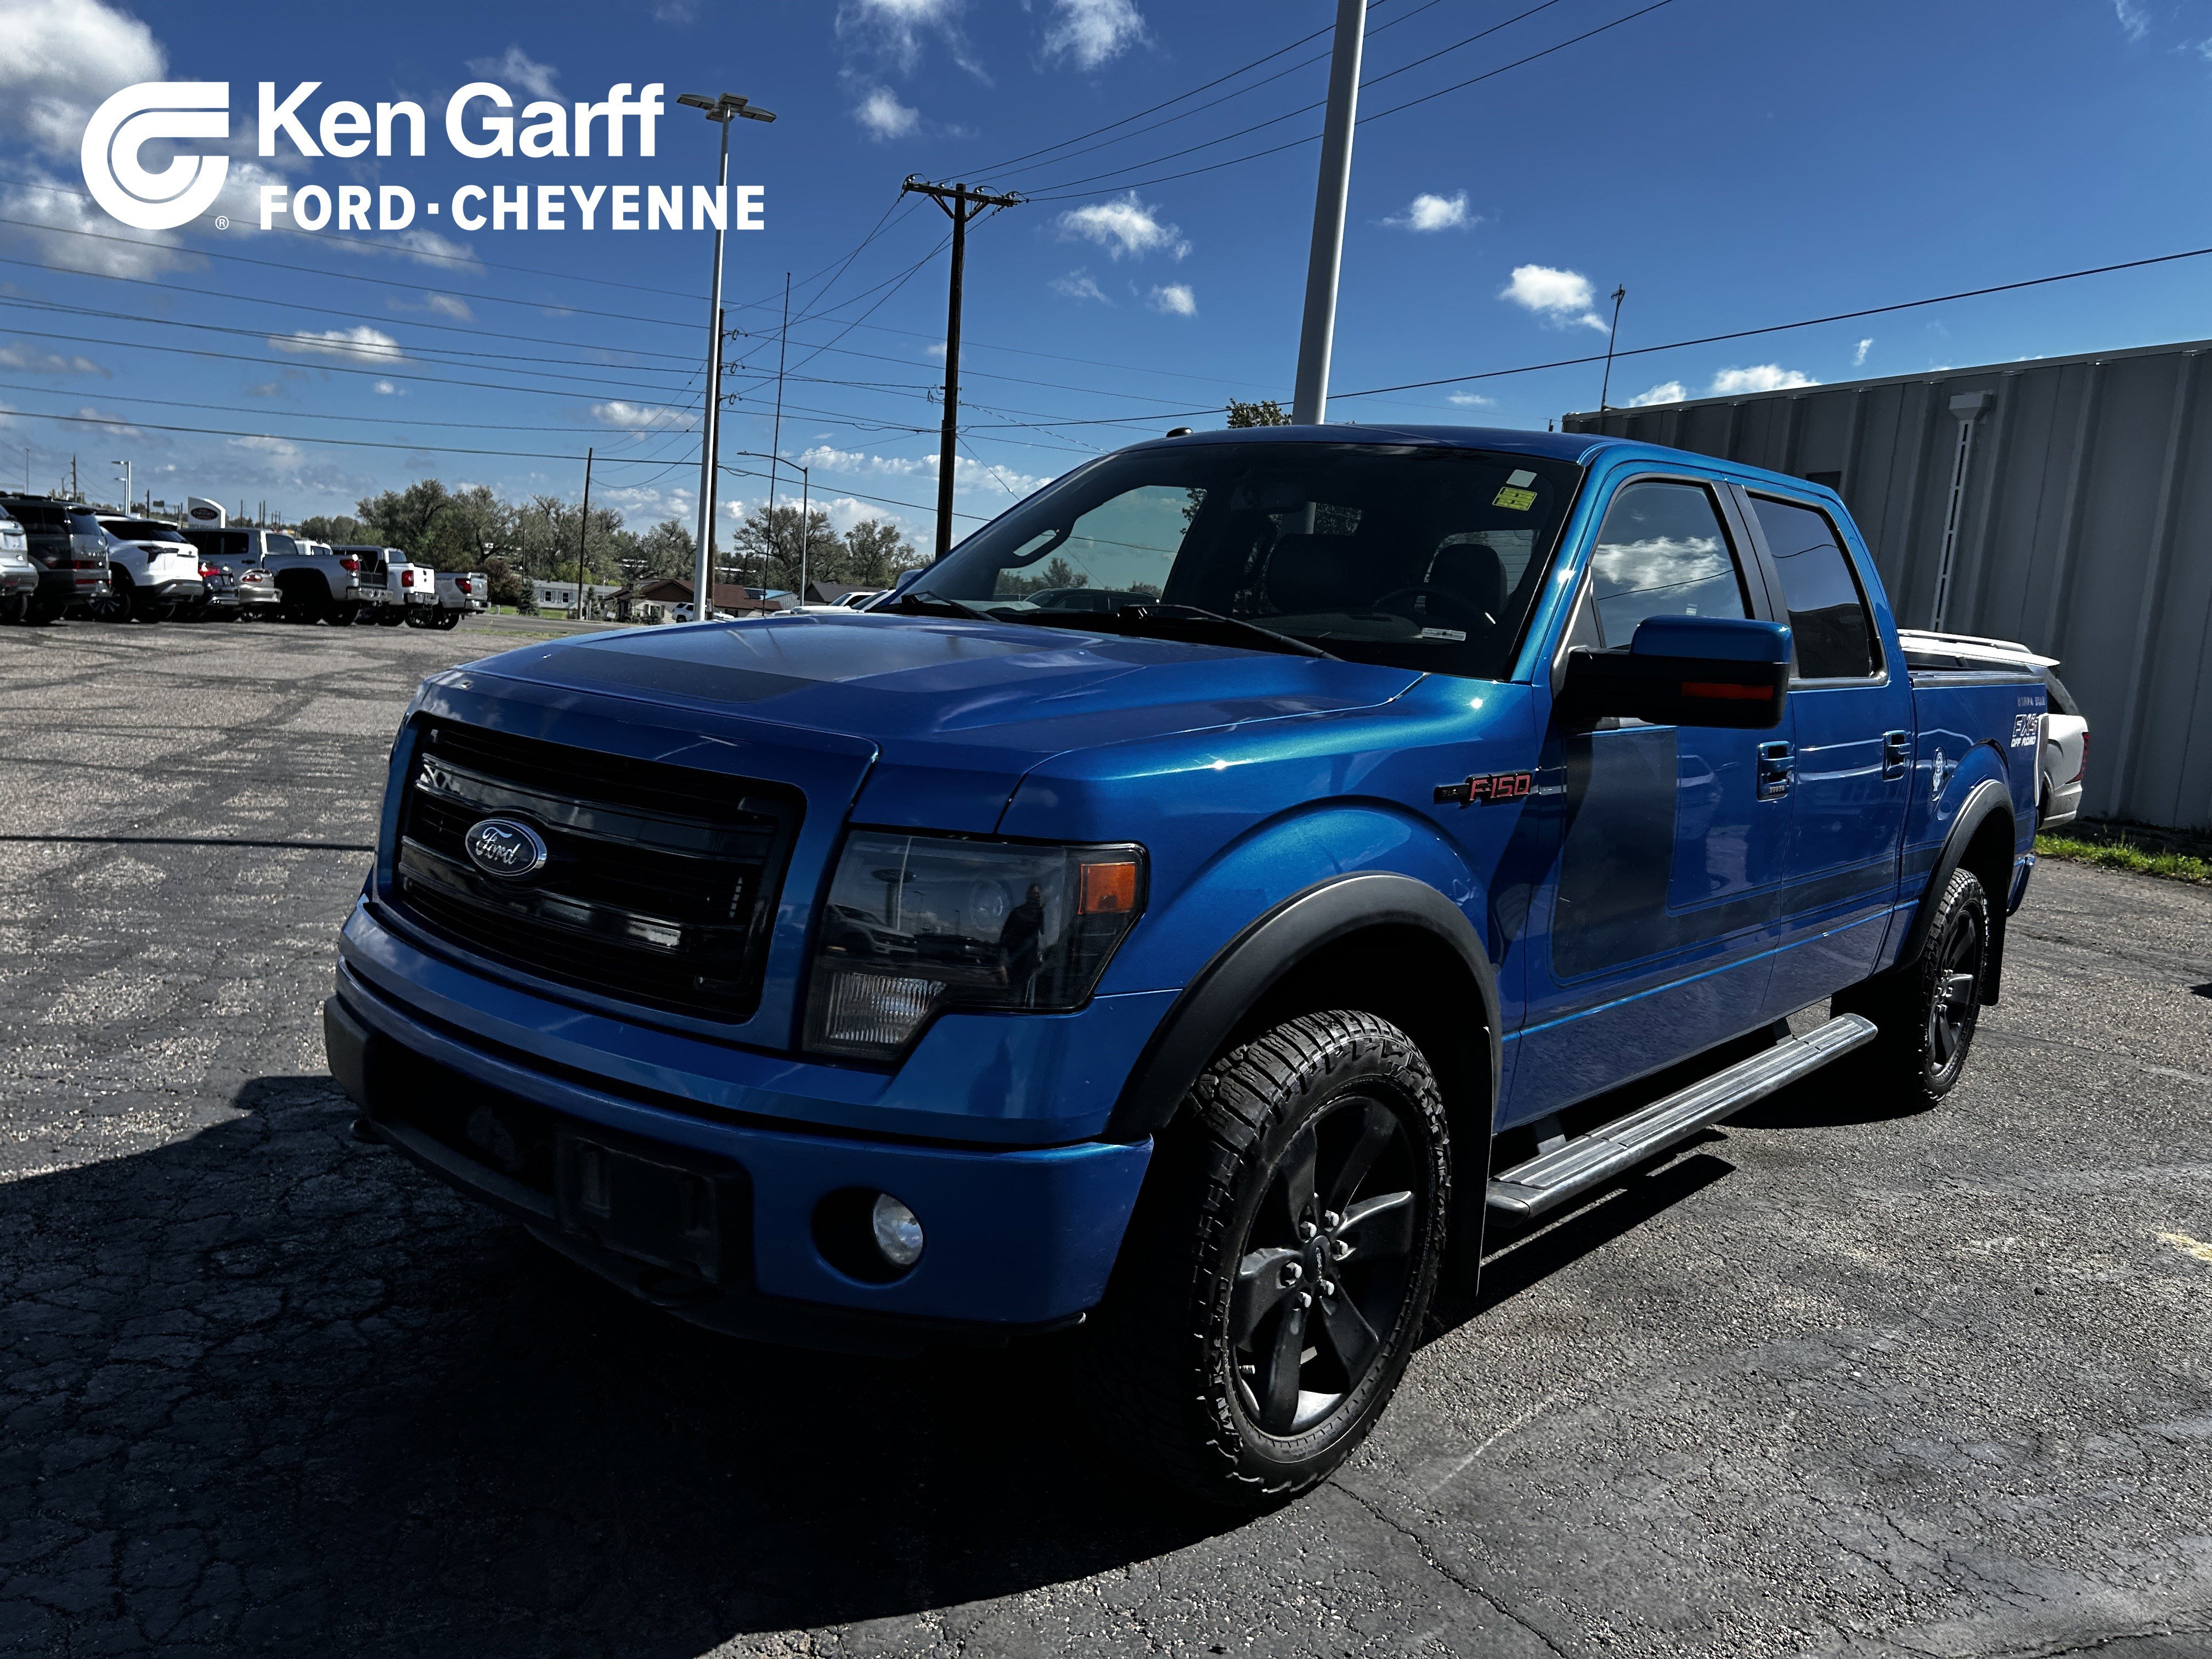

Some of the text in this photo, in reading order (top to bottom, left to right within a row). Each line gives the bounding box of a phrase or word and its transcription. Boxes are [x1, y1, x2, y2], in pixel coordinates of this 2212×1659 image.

[2010, 736, 2036, 748] OFF ROAD
[1469, 774, 1531, 802] F-150
[475, 826, 522, 866] Ford
